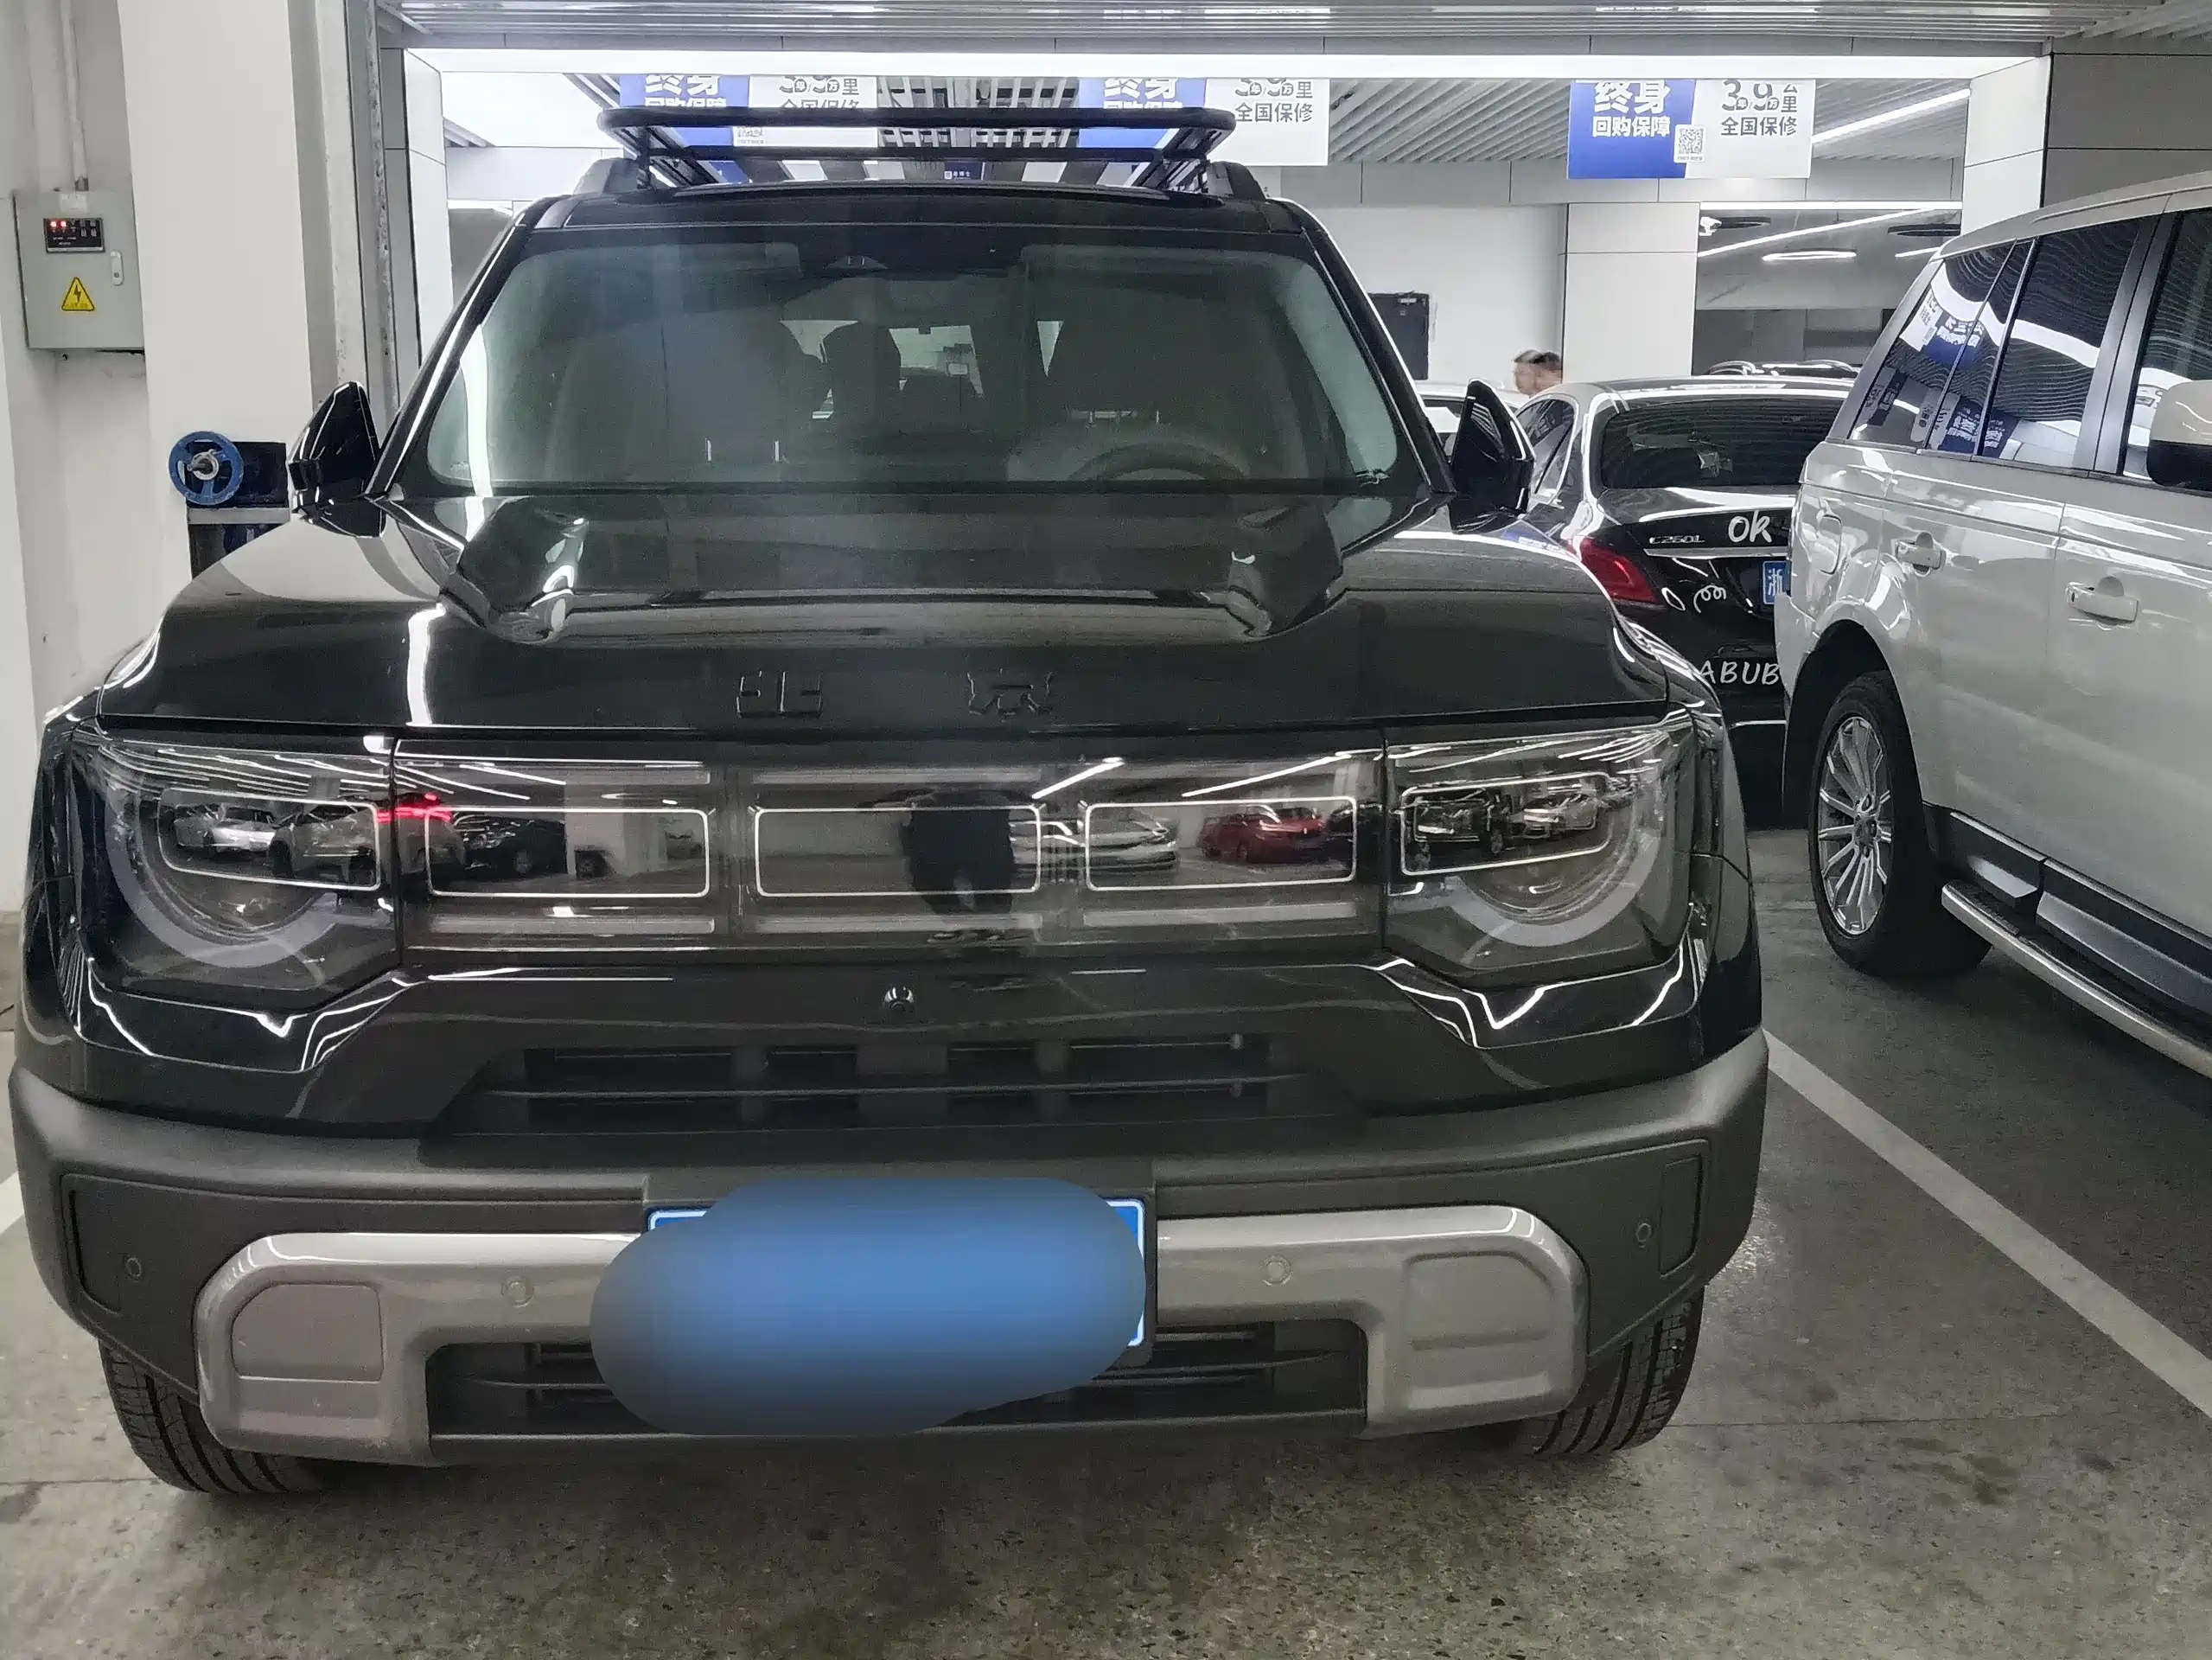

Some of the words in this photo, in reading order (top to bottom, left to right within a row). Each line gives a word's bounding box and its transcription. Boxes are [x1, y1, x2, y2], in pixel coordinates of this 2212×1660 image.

[1594, 80, 1671, 113] 终身
[1234, 102, 1313, 123] 全国保修
[1592, 116, 1671, 137] 回购保障
[1721, 116, 1797, 136] 全国保修
[1768, 567, 1783, 596] 浙
